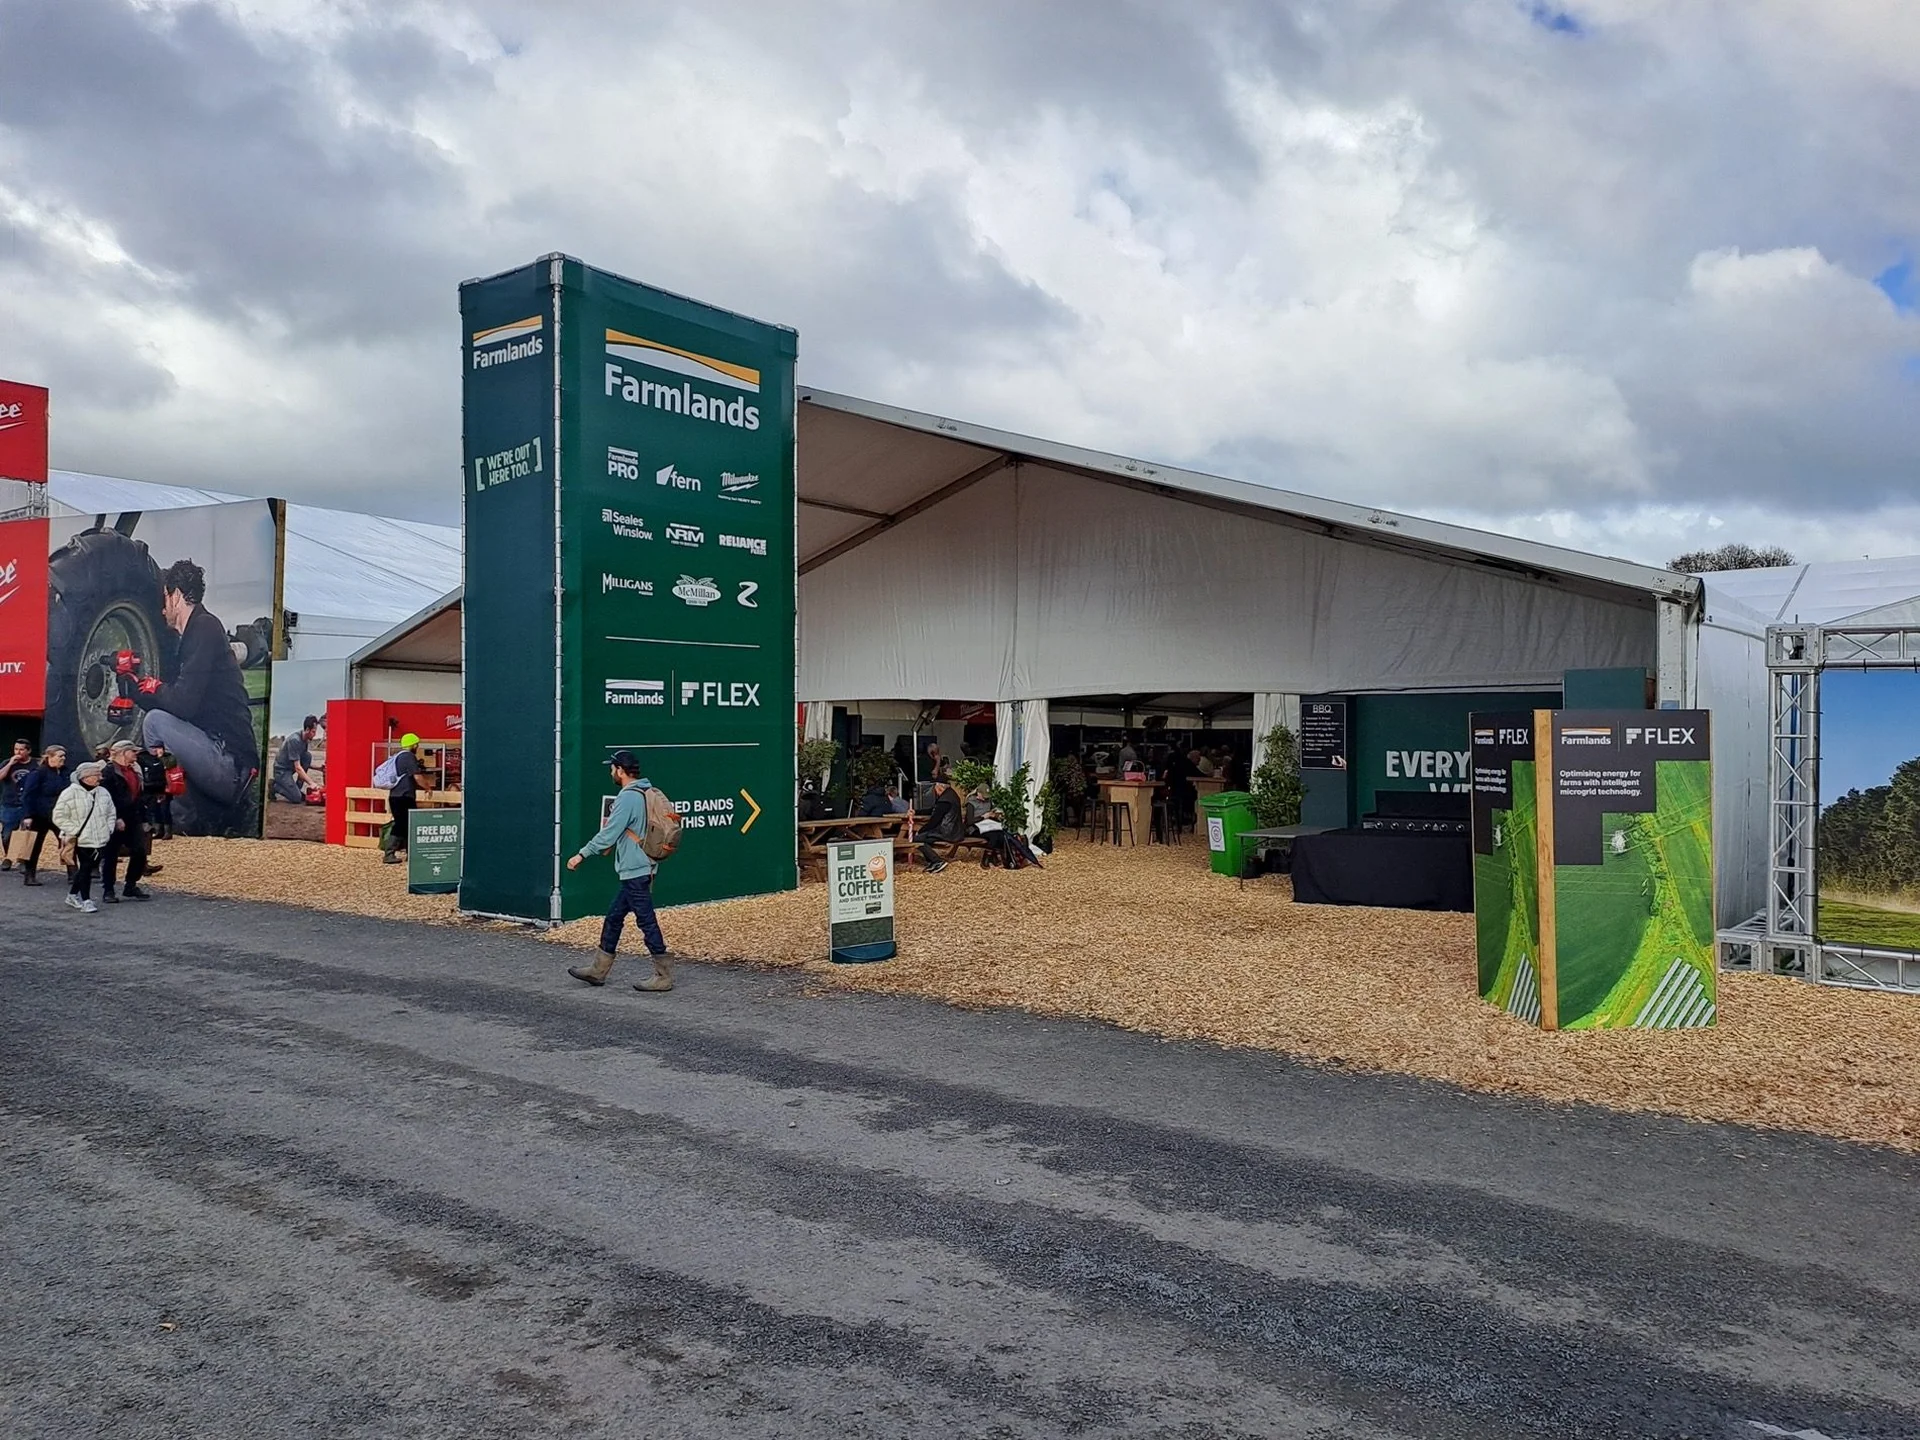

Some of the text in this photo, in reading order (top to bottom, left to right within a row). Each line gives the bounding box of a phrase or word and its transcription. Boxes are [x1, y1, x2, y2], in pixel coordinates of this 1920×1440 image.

[473, 336, 543, 369] Farmlands
[605, 362, 760, 431] Farmlands
[487, 443, 531, 471] WE'RE OUT
[608, 452, 639, 466] Farmlands
[488, 461, 530, 487] HERE TOO.
[608, 461, 639, 480] PRO
[670, 471, 702, 492] fern
[613, 511, 644, 527] Seales
[665, 527, 705, 544] NRM
[718, 534, 767, 550] RELIANCE
[677, 586, 717, 599] McMillan
[605, 681, 761, 707] Farmlands FLEX
[1312, 704, 1333, 713] BBQ
[1506, 728, 1529, 745] FLEX
[1561, 727, 1696, 745] Farmlands FLEX
[1386, 750, 1472, 778] EVERY
[1559, 769, 1642, 779] Optimising energy for
[1601, 779, 1640, 788] intelligent
[1559, 788, 1642, 797] microgrid technology.
[693, 798, 734, 812] BANDS
[681, 814, 735, 829] THIS WAY
[416, 825, 458, 836] FREE BBQ
[416, 835, 458, 844] BREAKFAST
[838, 865, 867, 881] FREE
[838, 880, 884, 897] COFFEE
